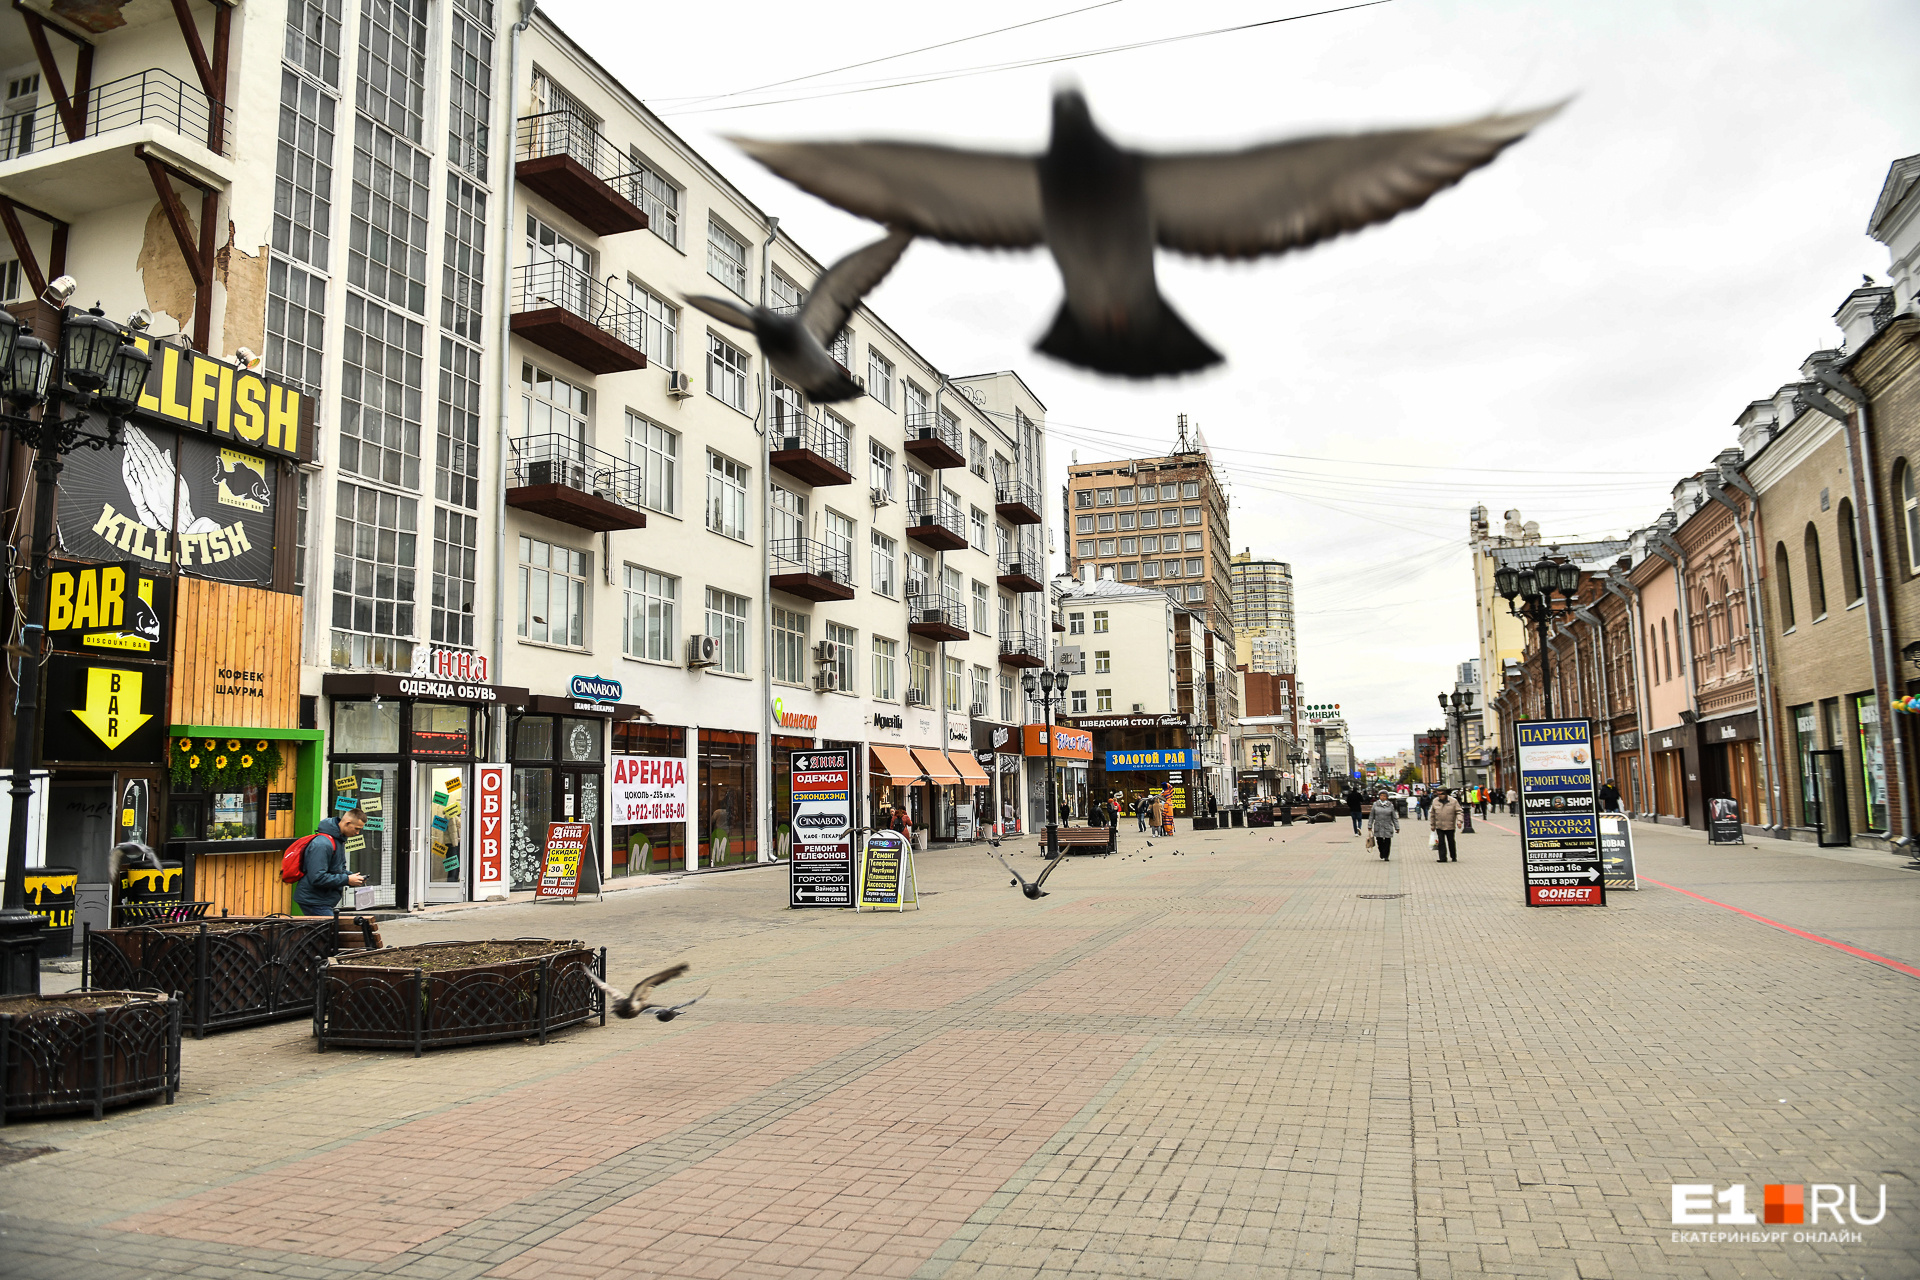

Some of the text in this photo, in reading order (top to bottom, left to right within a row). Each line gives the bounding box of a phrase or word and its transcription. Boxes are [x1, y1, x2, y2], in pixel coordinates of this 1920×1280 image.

[70, 314, 300, 453] LLFISH
[92, 502, 252, 566] KILLFISH
[48, 566, 125, 630] BAR
[86, 636, 127, 646] DISCOUNT
[218, 668, 264, 682] КОФЕЕК
[216, 685, 264, 698] ШАУРМА
[400, 679, 496, 700] ОДЕЖДА ОБУВЬ
[574, 679, 620, 697] CINNABON
[108, 673, 120, 738] BAR
[1080, 718, 1129, 727] ШВЕДСКИЙ
[1521, 726, 1586, 742] ПАРИКИ
[1112, 752, 1159, 765] ЗОЛОТОЙ
[1164, 751, 1186, 764] РАЙ
[614, 760, 684, 788] АРЕНДА
[797, 774, 843, 784] ОДЕЖДА
[1524, 775, 1591, 786] РЕМОНТ ЧАСОВ
[624, 792, 649, 800] ЦОКОЛЬ
[1525, 797, 1592, 807] VAPE SHOP
[627, 803, 685, 820] 8-922-181-85-80
[482, 772, 500, 880] ОБУВЬ
[799, 817, 844, 826] CINNABON
[1529, 819, 1591, 827] МЕХОВАЯ
[548, 841, 583, 849] ОБУВЬ
[798, 874, 844, 882] ГОРСТРОЙ
[1538, 889, 1592, 898] ФОНБЕТ
